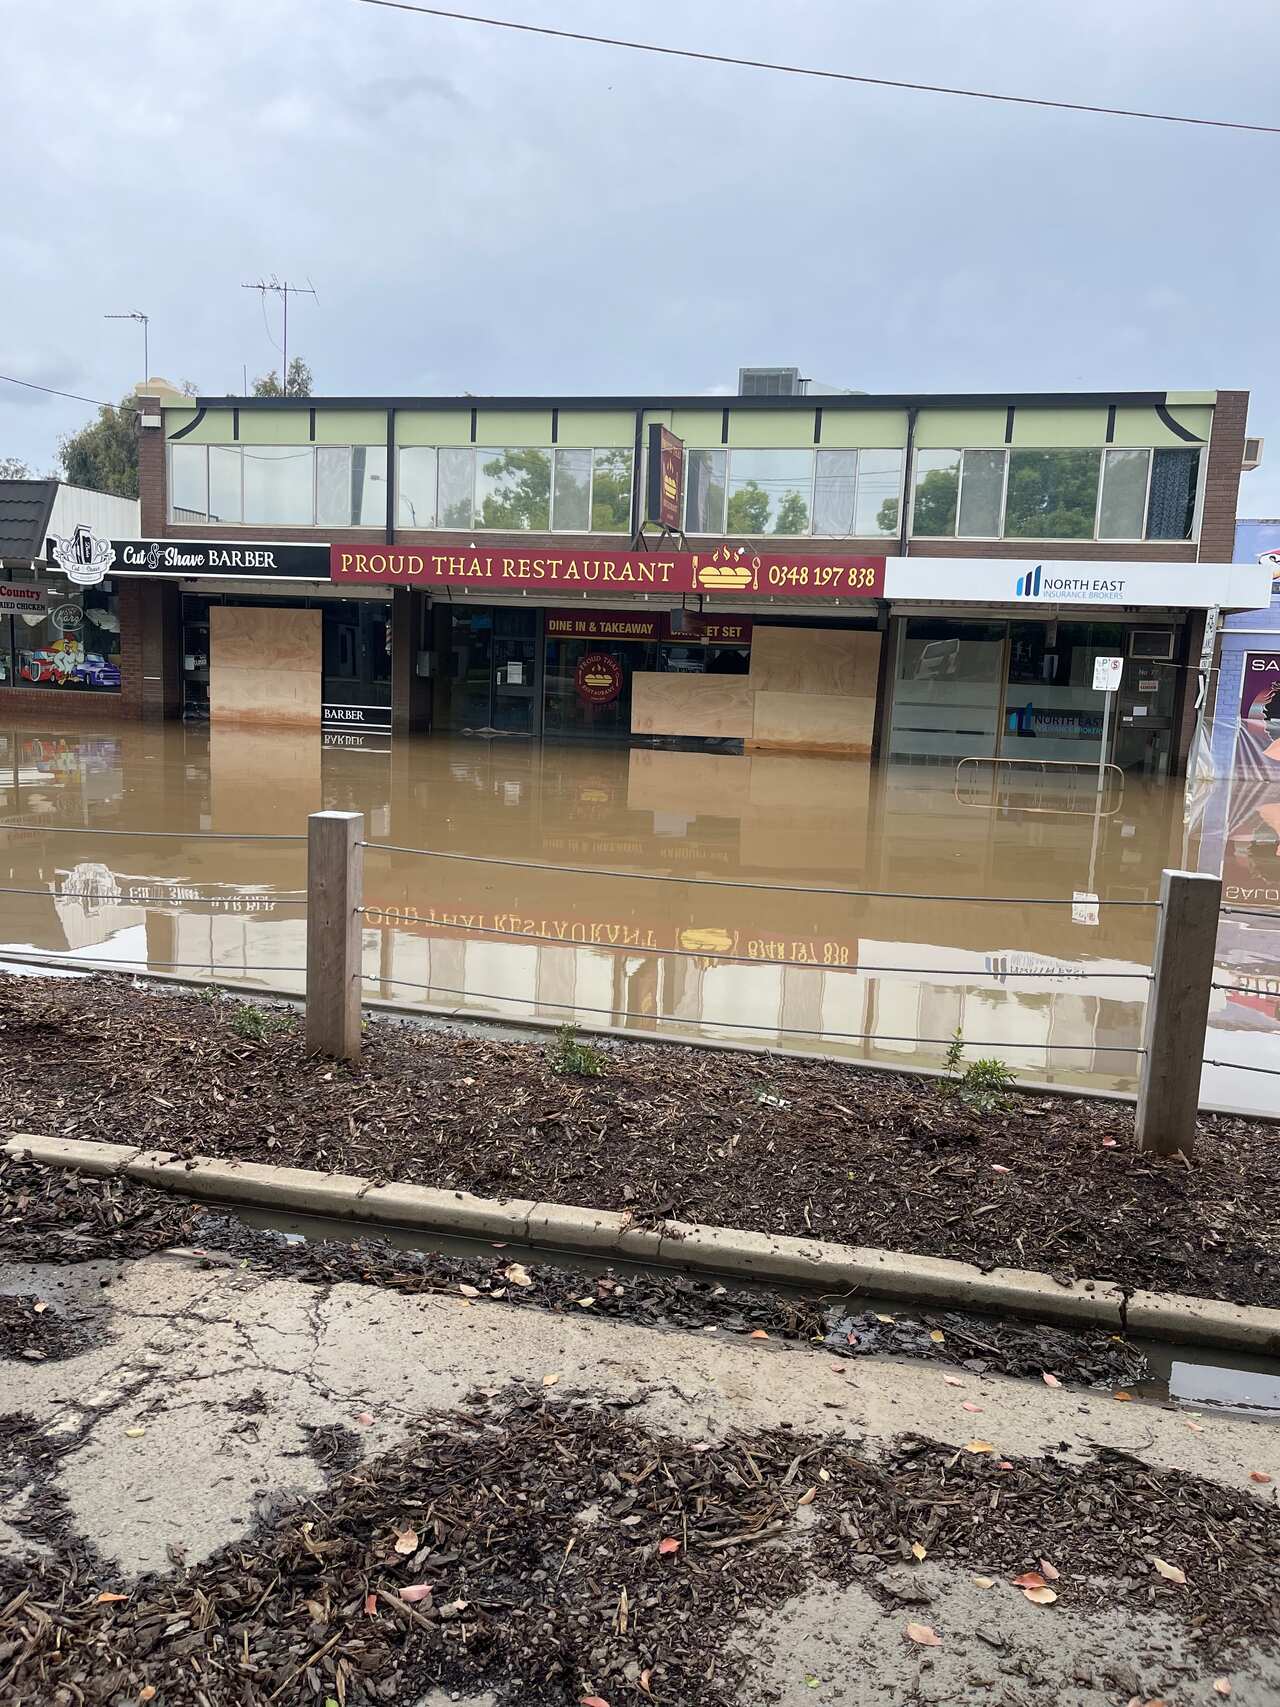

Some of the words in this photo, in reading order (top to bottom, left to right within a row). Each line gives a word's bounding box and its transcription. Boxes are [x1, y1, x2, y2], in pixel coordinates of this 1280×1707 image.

[123, 546, 146, 565] Cut
[165, 547, 205, 567] Shave
[208, 550, 278, 568] BARBER
[341, 553, 424, 575] PROUD
[431, 555, 493, 578] THAI
[502, 558, 674, 582] RESTAURANT
[768, 565, 809, 586] 0348
[813, 567, 844, 587] 197
[847, 567, 876, 588] 838
[1043, 579, 1090, 590] NORTH
[1092, 580, 1126, 591] EAST
[0, 585, 42, 601] Country
[1043, 590, 1088, 599] INSURANCE
[1088, 591, 1124, 600] BROKERS
[16, 603, 46, 611] CHICKEN
[549, 620, 573, 631] DINE
[575, 621, 586, 632] IN
[588, 622, 597, 632] &
[599, 622, 654, 635] TAKEAWAY
[722, 626, 743, 638] SET
[324, 709, 365, 721] BARBER
[1034, 713, 1075, 726] NORTH
